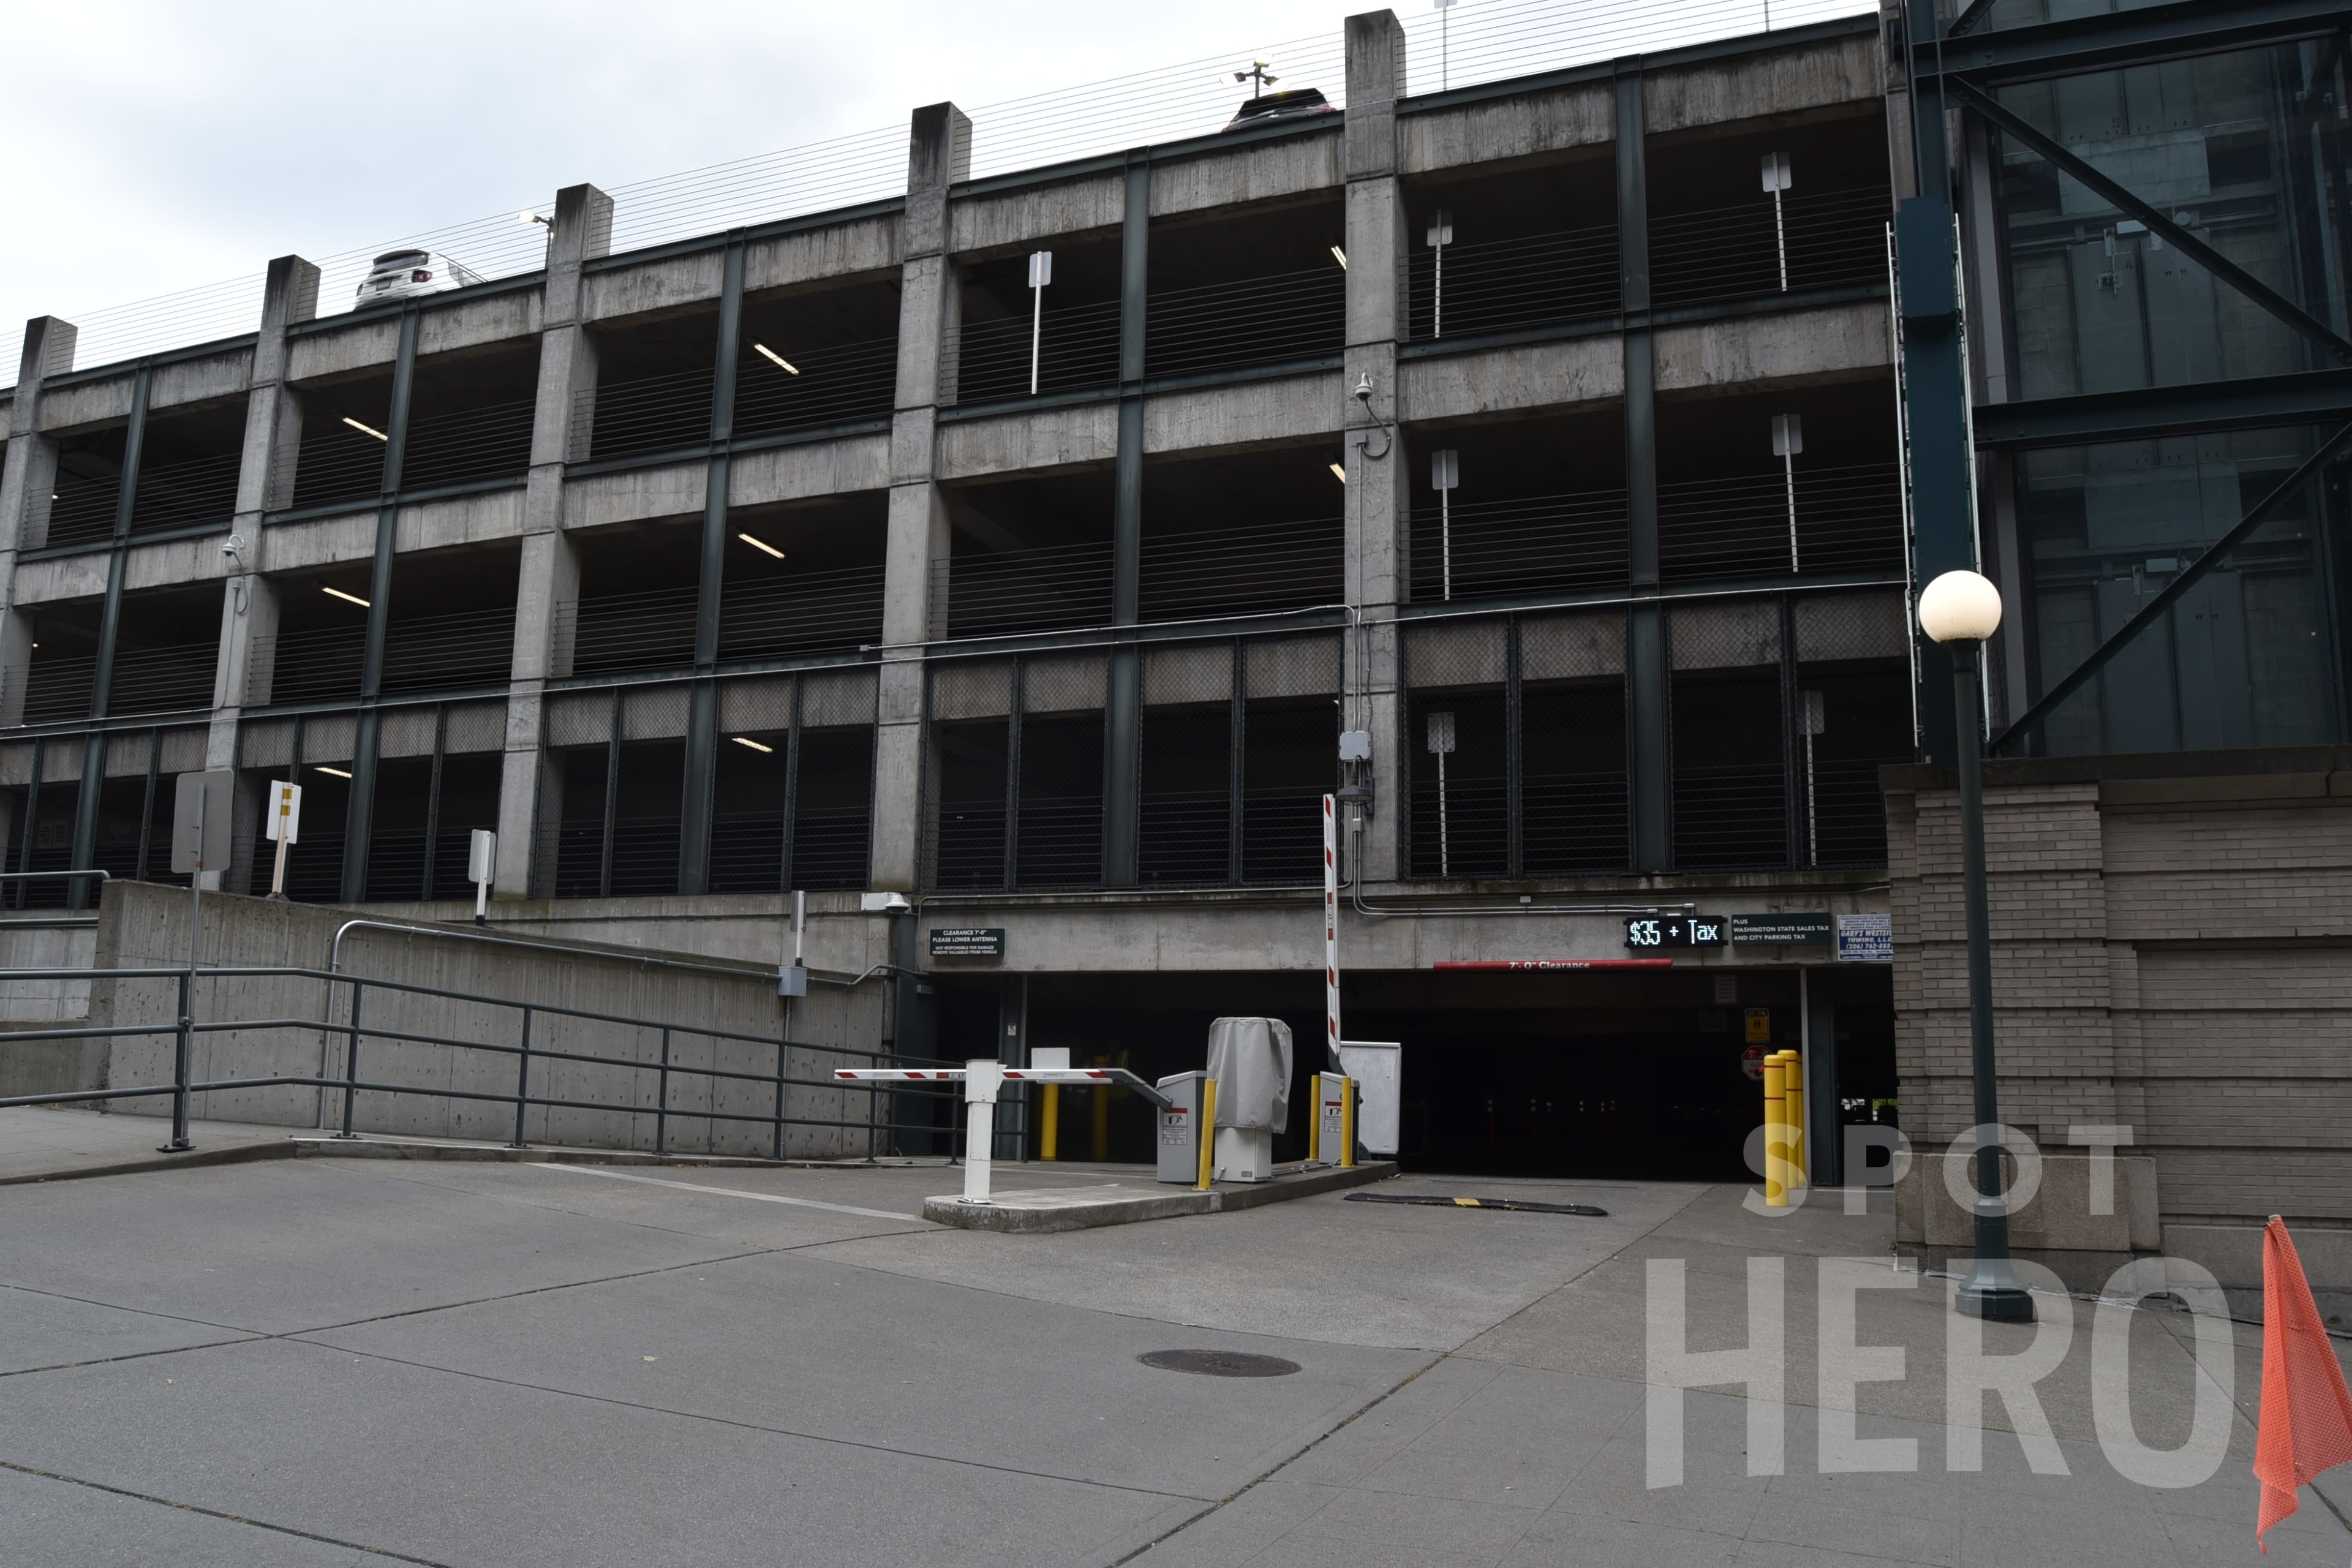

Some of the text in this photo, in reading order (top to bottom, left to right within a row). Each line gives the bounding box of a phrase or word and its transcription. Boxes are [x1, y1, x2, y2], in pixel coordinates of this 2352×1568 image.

[1630, 920, 1718, 945] $35 + Tax
